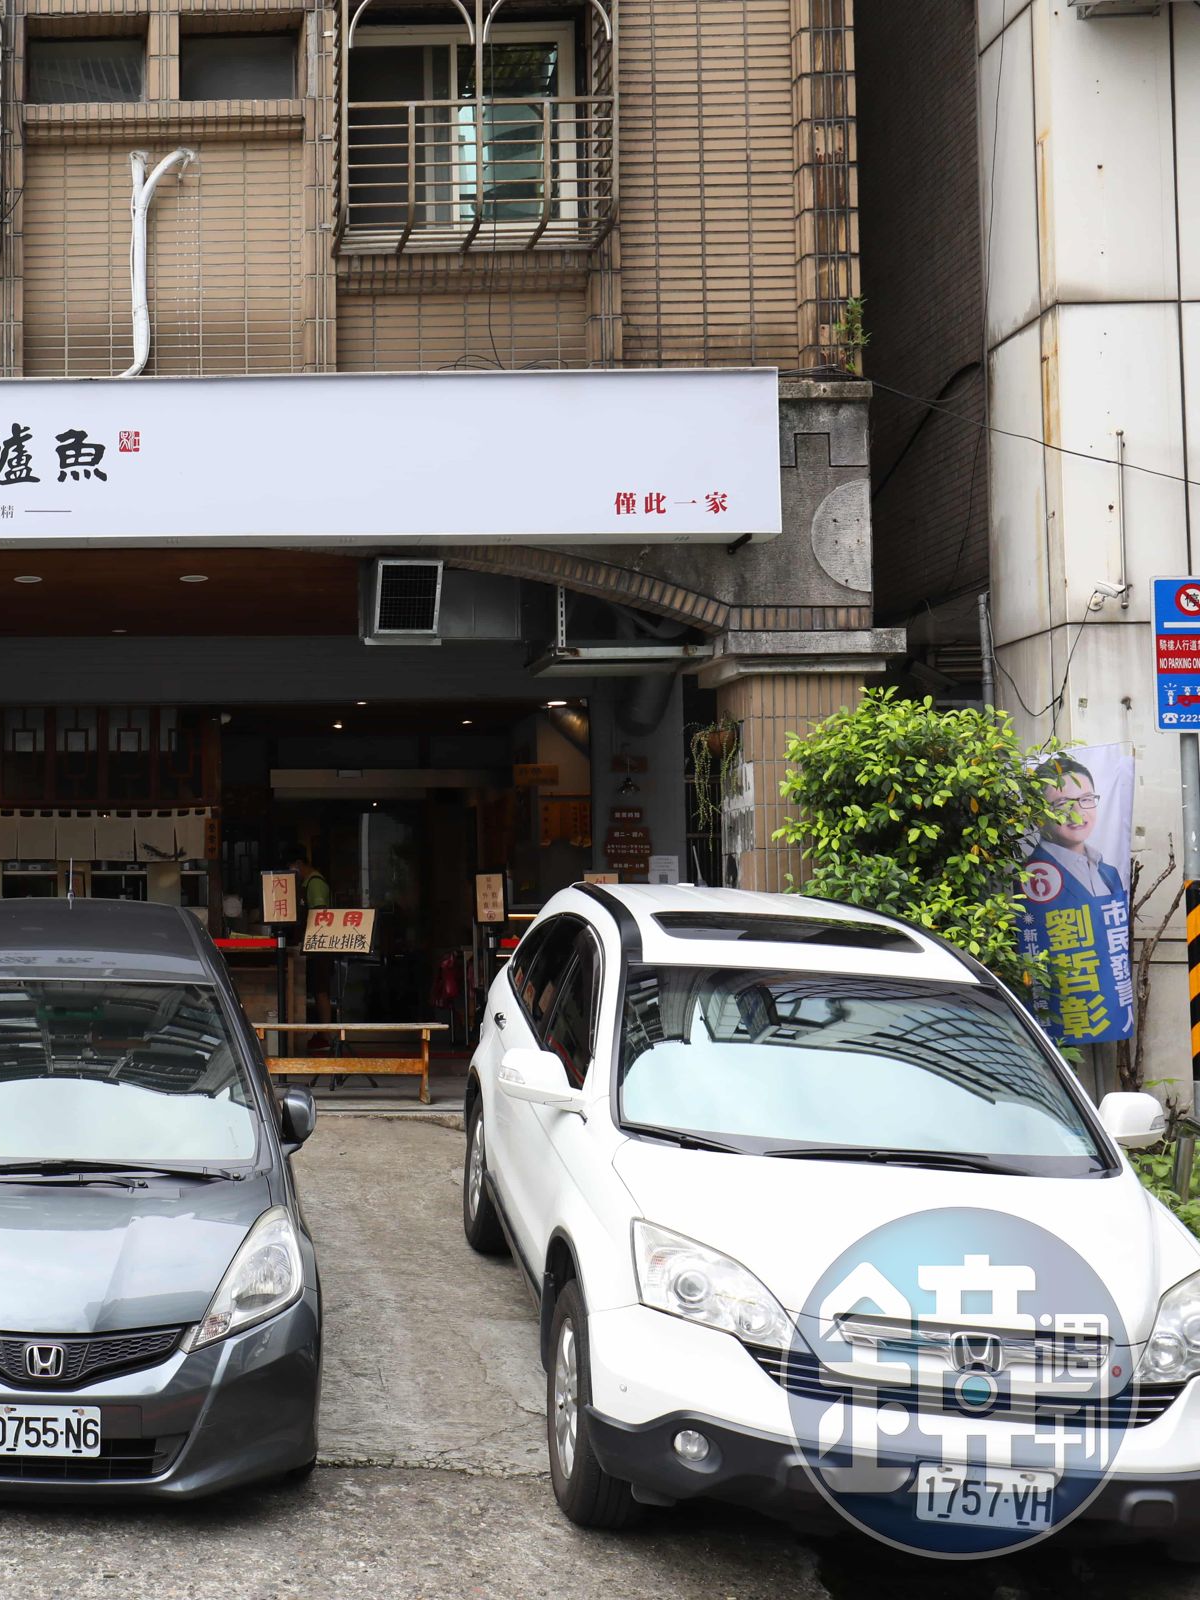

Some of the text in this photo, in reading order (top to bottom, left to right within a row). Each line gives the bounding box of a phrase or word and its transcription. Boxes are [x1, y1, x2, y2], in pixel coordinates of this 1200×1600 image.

[614, 491, 728, 515] 僅此一家
[1160, 657, 1168, 669] NO
[1168, 658, 1192, 669] PARKING
[1180, 714, 1200, 722] 222
[1029, 868, 1052, 897] 6
[272, 877, 288, 918] 內用
[314, 911, 364, 928] 內用
[304, 934, 367, 950] 請在此排隊
[1045, 904, 1111, 1039] 劉哲彰
